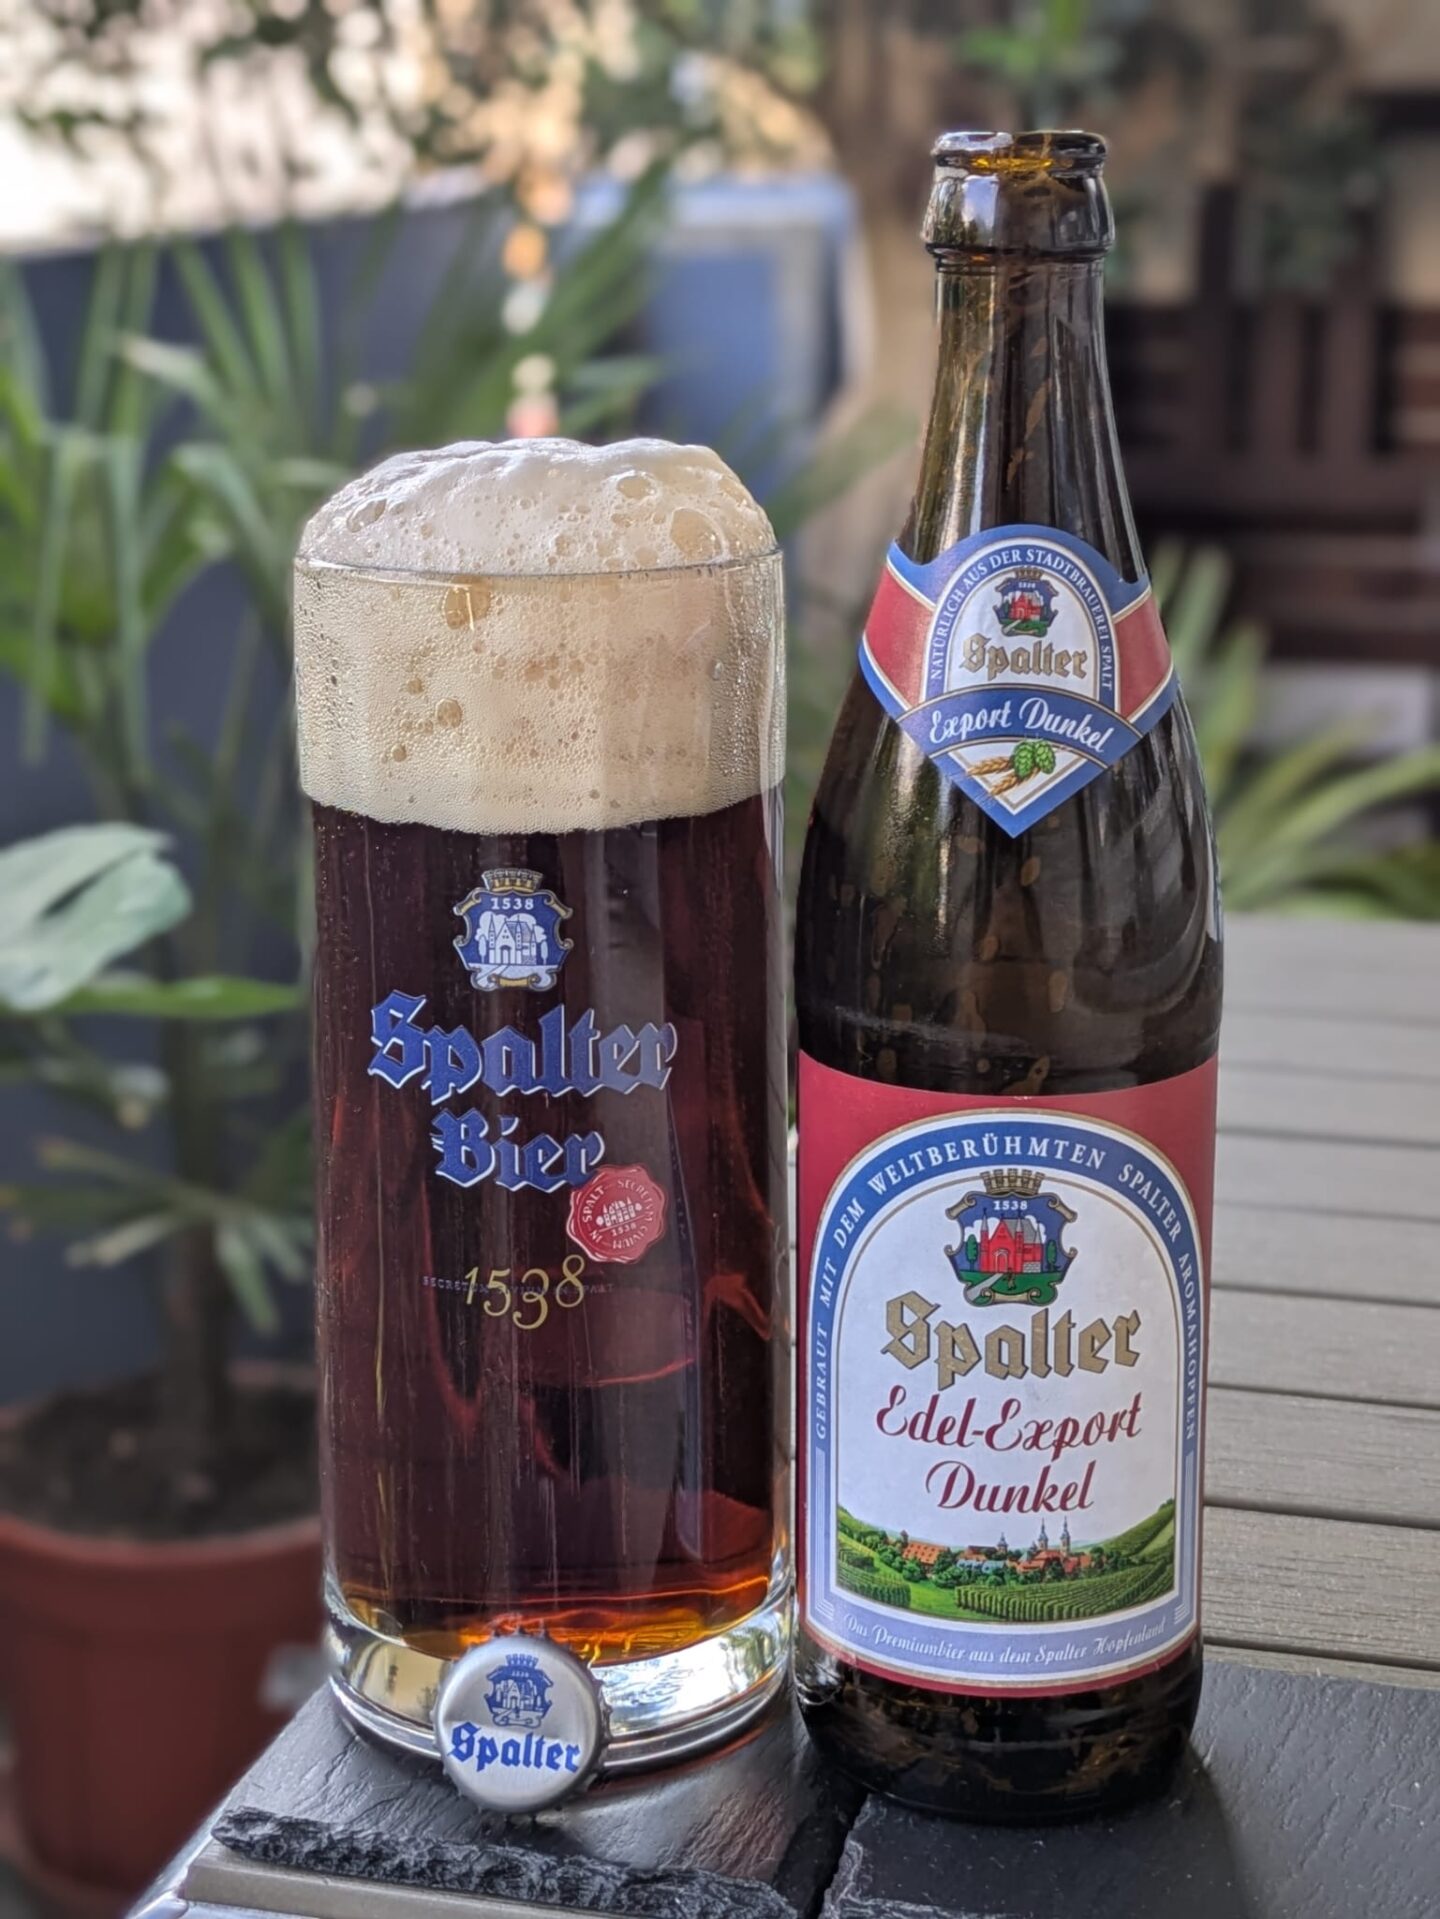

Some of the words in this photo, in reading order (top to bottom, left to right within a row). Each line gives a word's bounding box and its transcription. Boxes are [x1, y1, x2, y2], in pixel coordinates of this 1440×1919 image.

[962, 564, 988, 590] AUS
[989, 549, 1021, 569] DER
[1026, 548, 1109, 640] STADTBRAUEREI
[1101, 645, 1113, 691] SPALT
[959, 633, 1088, 681] Spalter
[929, 700, 1011, 744] Export
[1019, 697, 1114, 752] Dunkel
[490, 897, 534, 910] 1538
[367, 989, 678, 1105] Spalter
[430, 1107, 605, 1193] Bier
[867, 1132, 1107, 1196] WELTBERÜHMTEN
[582, 1185, 605, 1223] SPALT
[833, 1197, 865, 1249] DEM
[993, 1200, 1028, 1211] 1538
[1118, 1163, 1182, 1243] SPALTER
[464, 1254, 585, 1330] 1538
[819, 1257, 837, 1309] MIT
[880, 1290, 1141, 1391] Spalter
[815, 1322, 828, 1439] GEBRAUT
[876, 1384, 1142, 1462] Edel-Export
[925, 1459, 1097, 1514] Dunkel
[844, 1614, 868, 1637] Das
[872, 1624, 966, 1662] Premiumbier
[969, 1651, 994, 1663] aus
[1000, 1646, 1030, 1664] dem
[1034, 1643, 1088, 1666] Spalter
[447, 1721, 581, 1773] Spalter
